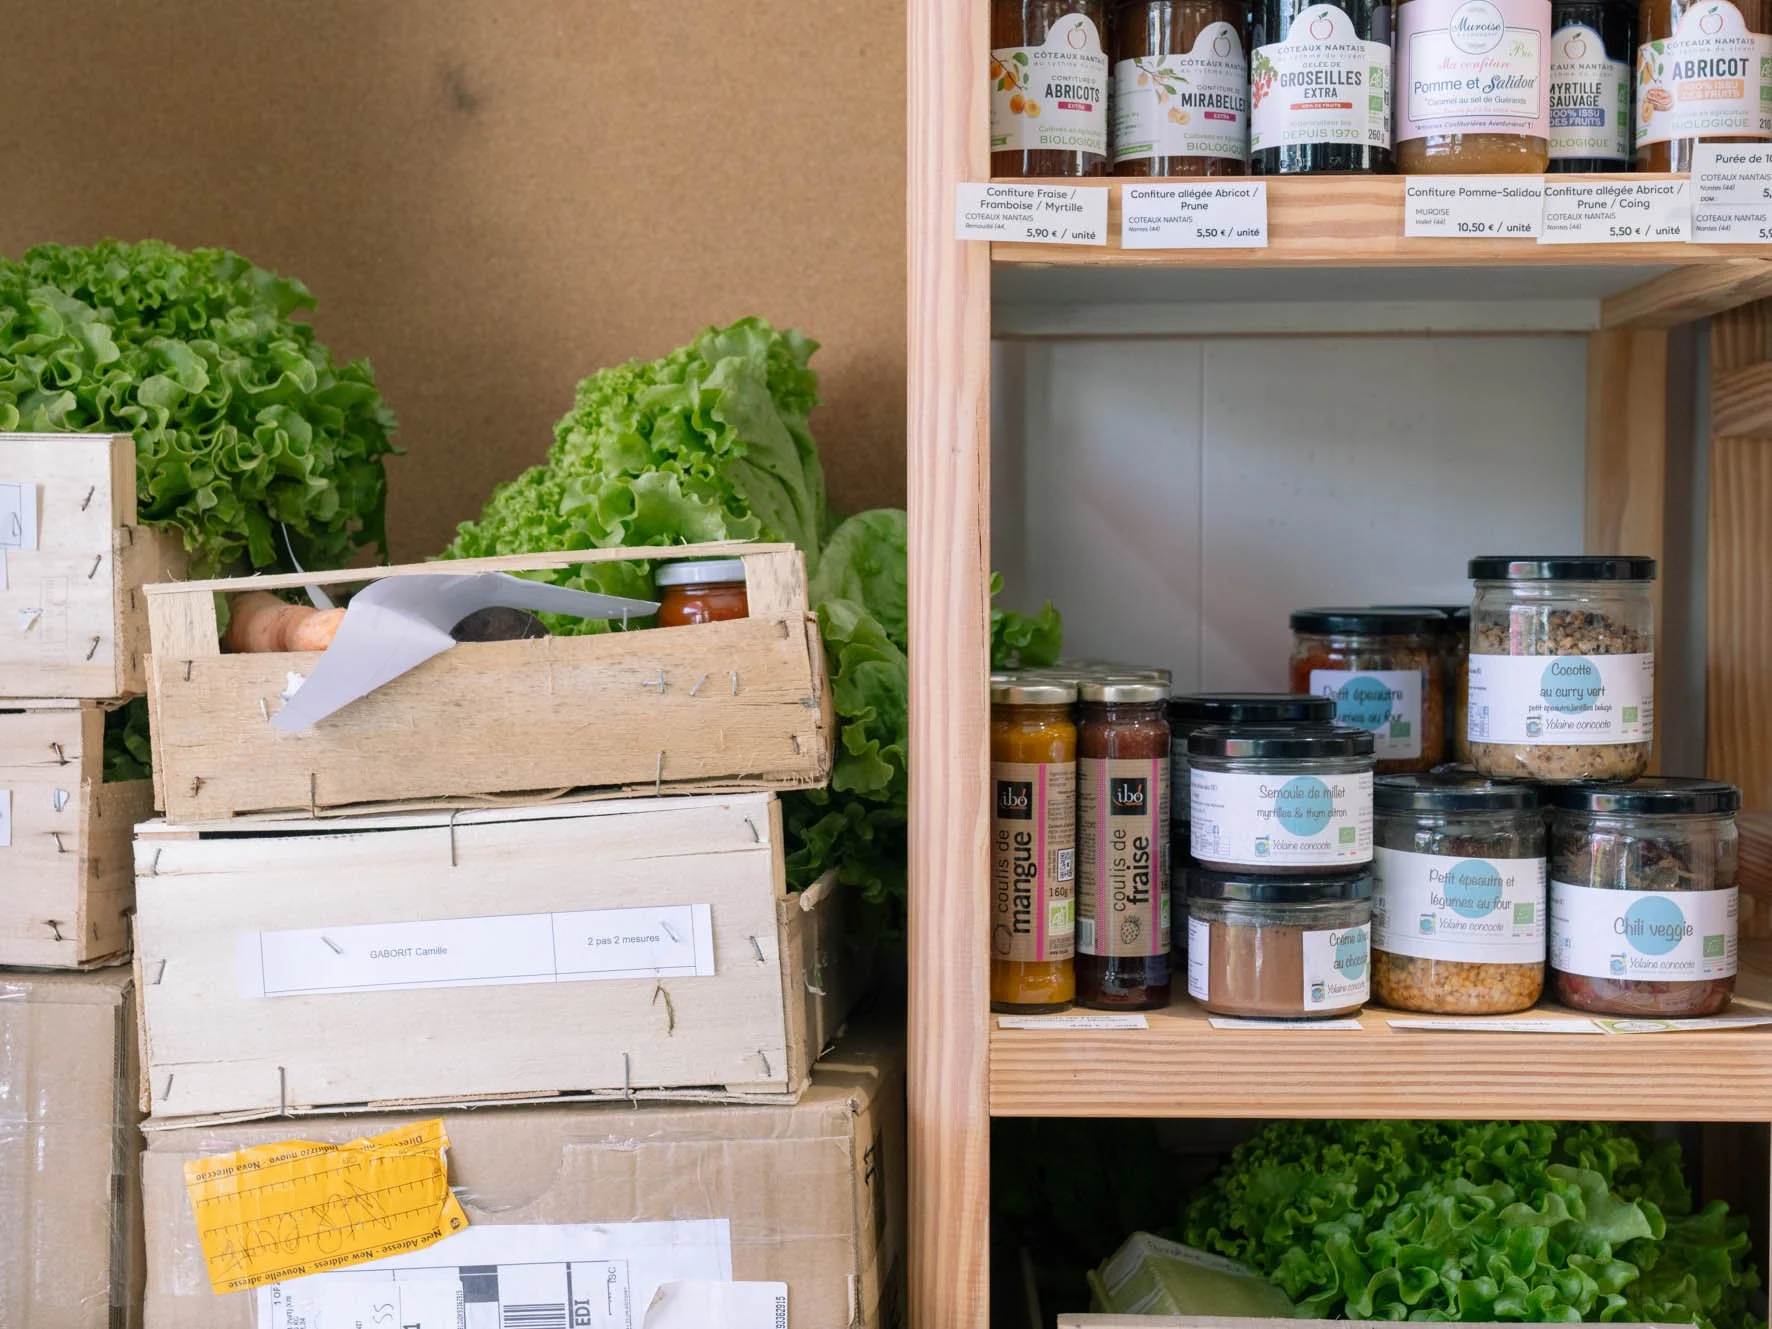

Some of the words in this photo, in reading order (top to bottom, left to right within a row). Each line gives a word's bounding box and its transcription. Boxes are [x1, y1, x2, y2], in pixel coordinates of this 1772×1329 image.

[1325, 44, 1365, 52] NANTAIS
[1672, 58, 1750, 80] ABRICOT
[1280, 70, 1362, 88] GROSEILLES
[1414, 79, 1462, 94] Pomme
[1466, 78, 1480, 89] et
[1045, 84, 1100, 102] ABRICOTS
[1304, 88, 1338, 99] EXTRA
[1550, 95, 1600, 108] SAUVAGE
[1579, 109, 1600, 118] ISSU
[1570, 117, 1601, 126] FRUITS
[1671, 119, 1750, 129] BIOLOGIQUE
[1283, 130, 1328, 139] DEPUIS
[1332, 128, 1359, 138] 1970
[1369, 129, 1380, 141] 260
[1550, 139, 1609, 148] OLOGIQUE
[1716, 154, 1746, 164] Purée
[1749, 154, 1762, 163] de
[986, 187, 1034, 197] Confiture
[1037, 189, 1067, 199] Fraise
[1131, 190, 1175, 199] Confiture
[1178, 189, 1213, 199] allégée
[1215, 188, 1250, 198] Abricot
[1407, 187, 1456, 197] Confiture
[1459, 187, 1541, 197] Pomme-Salidou
[1544, 187, 1593, 197] Confiture
[1596, 186, 1634, 197] allégée
[1636, 185, 1674, 194] Abricot
[980, 200, 1033, 210] Framboise
[1046, 202, 1083, 212] Myrtille
[1181, 202, 1208, 210] Prune
[1577, 200, 1607, 208] Prune
[1620, 199, 1650, 210] Coing
[1026, 228, 1049, 238] 5,90
[1072, 231, 1096, 239] unité
[1196, 228, 1218, 238] 5,50
[1237, 228, 1260, 236] unité
[1457, 222, 1485, 233] 10,50
[1507, 224, 1531, 232] unité
[1610, 227, 1632, 237] 5,50
[1656, 226, 1681, 235] unité
[1552, 663, 1591, 676] Cocotte
[1540, 688, 1552, 697] au
[1555, 688, 1584, 701] curry
[1587, 686, 1606, 697] vert
[1546, 719, 1574, 729] Yolaine
[1260, 785, 1304, 799] Semoule
[1308, 785, 1320, 799] de
[1324, 785, 1345, 799] millet
[1307, 808, 1326, 820] thym
[995, 830, 1009, 850] de
[1110, 829, 1126, 851] de
[1127, 836, 1150, 906] fraise
[1013, 832, 1037, 934] mangue
[1429, 868, 1455, 884] Petit
[1506, 875, 1515, 887] et
[995, 859, 1009, 913] coulis
[1110, 859, 1126, 912] coulis
[1049, 887, 1068, 898] 160g
[1430, 892, 1473, 910] légumes
[1477, 899, 1490, 908] au
[1493, 895, 1513, 911] four
[1614, 916, 1644, 936] Chili
[1650, 920, 1694, 942] veggie
[587, 937, 593, 945] 2
[596, 938, 612, 947] pas
[614, 936, 619, 944] 2
[622, 935, 660, 943] mesures
[370, 948, 412, 959] GABORIT
[415, 946, 447, 956] Camille
[1334, 960, 1343, 969] au
[236, 1160, 261, 1171] Nova
[387, 1235, 418, 1251] Adresse
[314, 1253, 350, 1268] address
[352, 1249, 374, 1261] New
[265, 1265, 305, 1280] Nouvelle
[227, 1274, 262, 1289] adresse
[273, 1287, 280, 1298] OF
